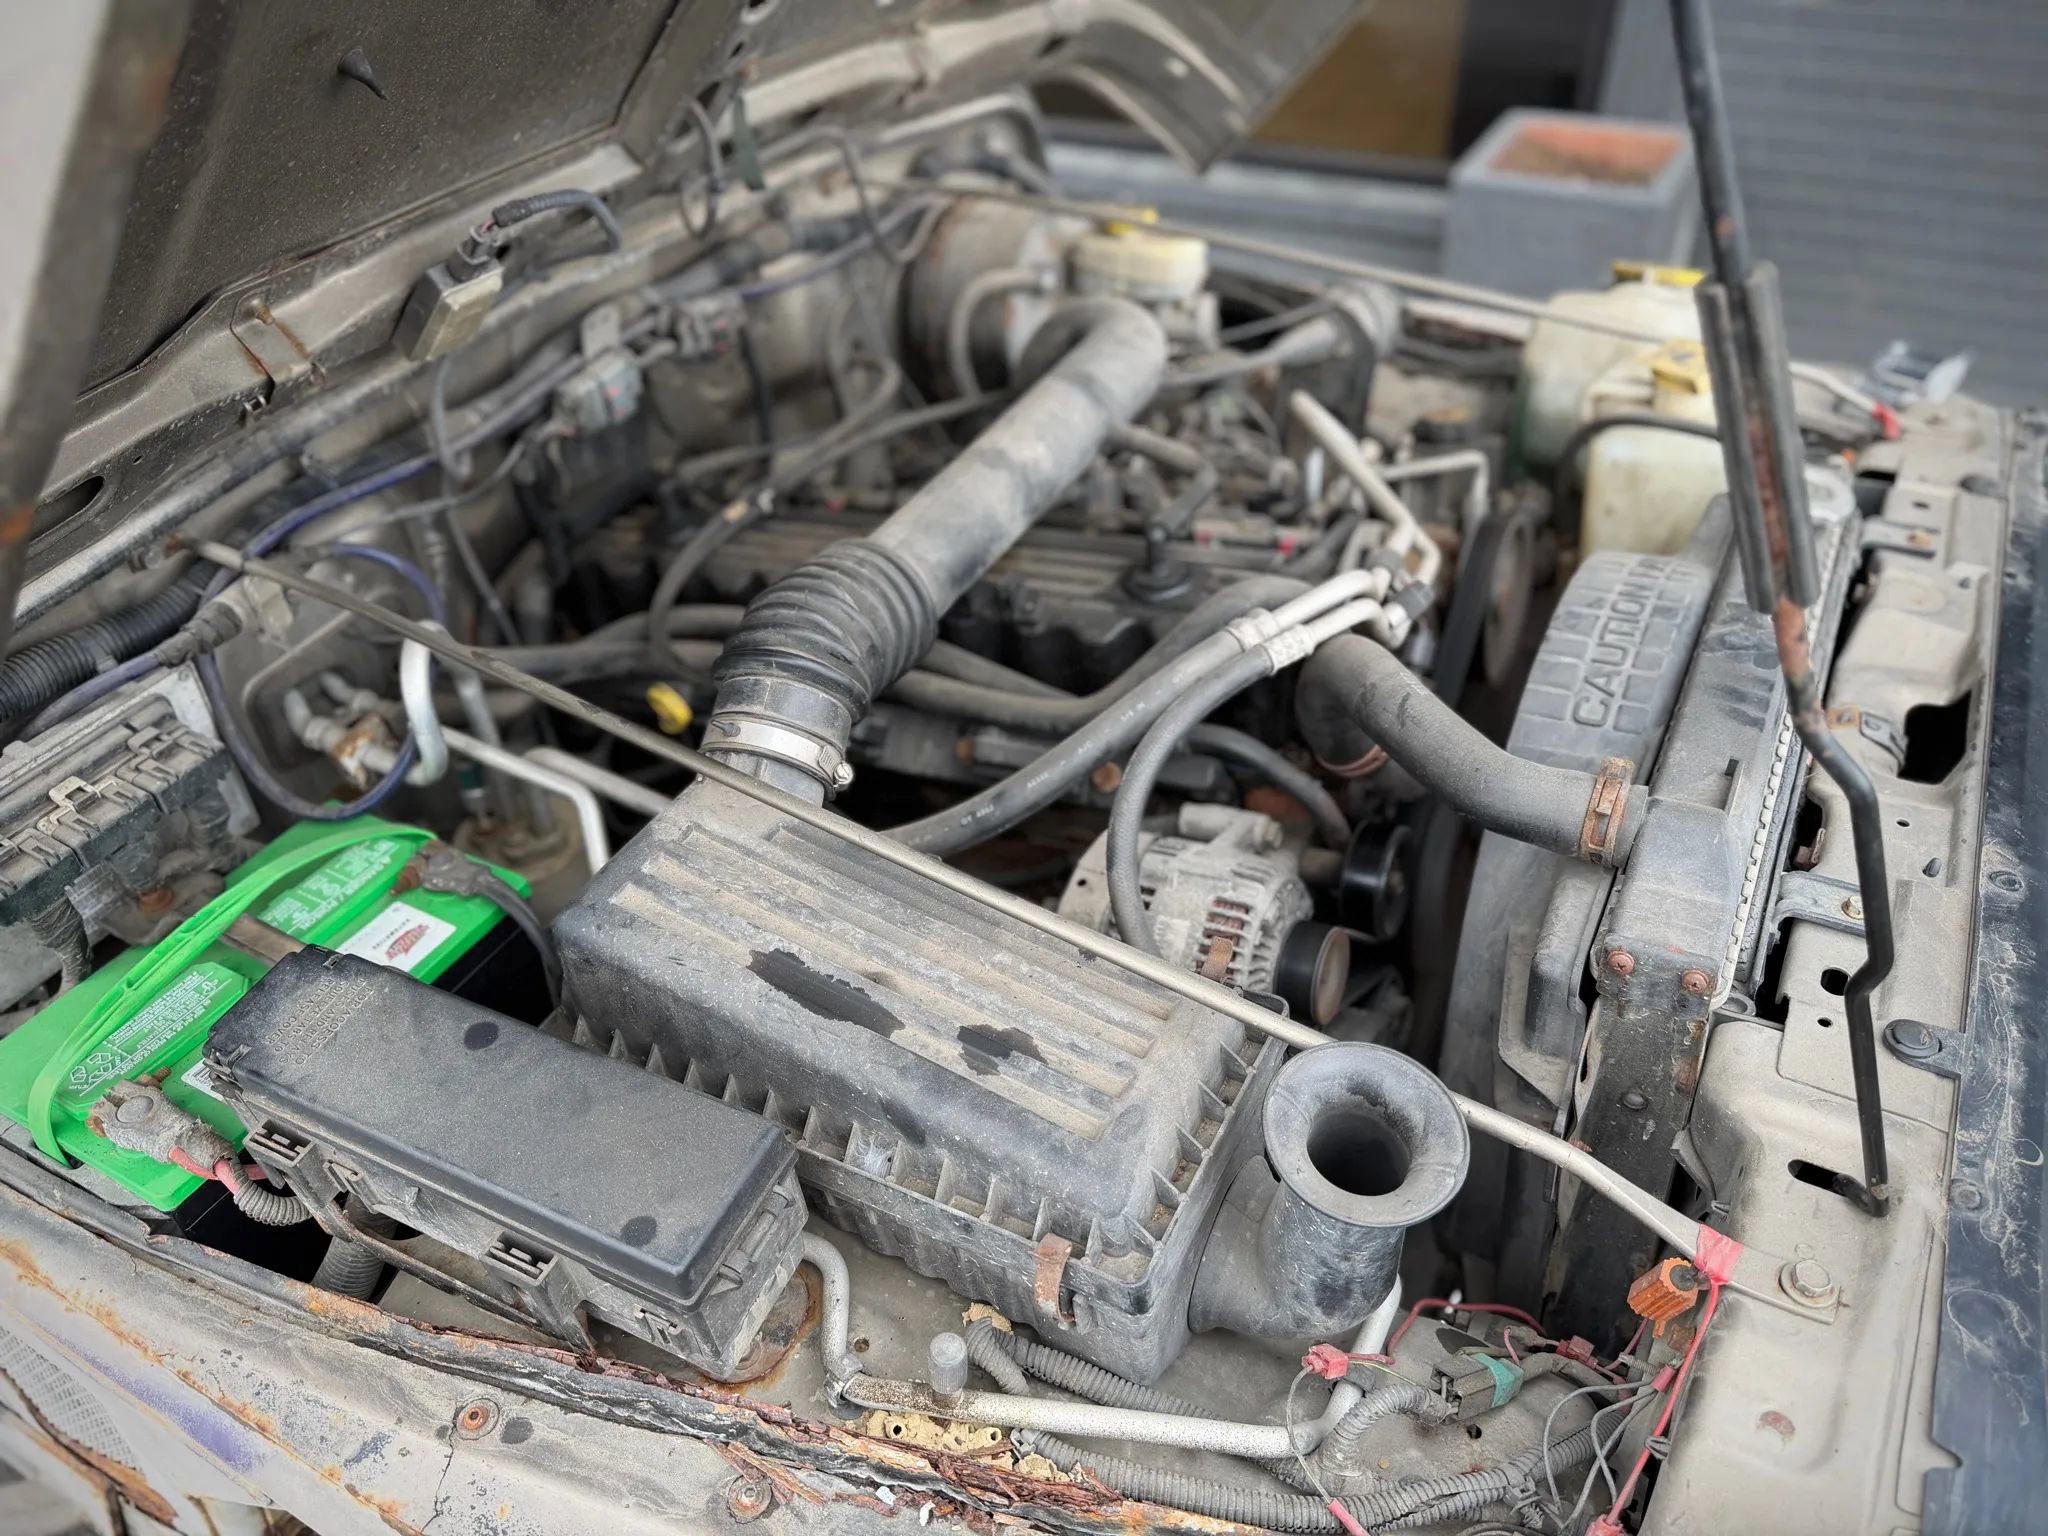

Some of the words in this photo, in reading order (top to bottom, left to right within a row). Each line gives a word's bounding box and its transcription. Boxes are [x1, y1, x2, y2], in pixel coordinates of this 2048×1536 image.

[1572, 582, 1655, 728] CAUTION
[296, 979, 335, 1016] RELEASE
[335, 978, 367, 1008] FUSES
[352, 986, 374, 1009] FOR
[265, 1016, 297, 1045] COVER
[288, 1018, 313, 1040] TABS
[311, 1009, 351, 1049] ACCESS
[316, 1008, 335, 1028] AND
[274, 1040, 289, 1053] TO
[279, 1029, 317, 1064] RELAYS
[295, 1052, 313, 1065] TO
